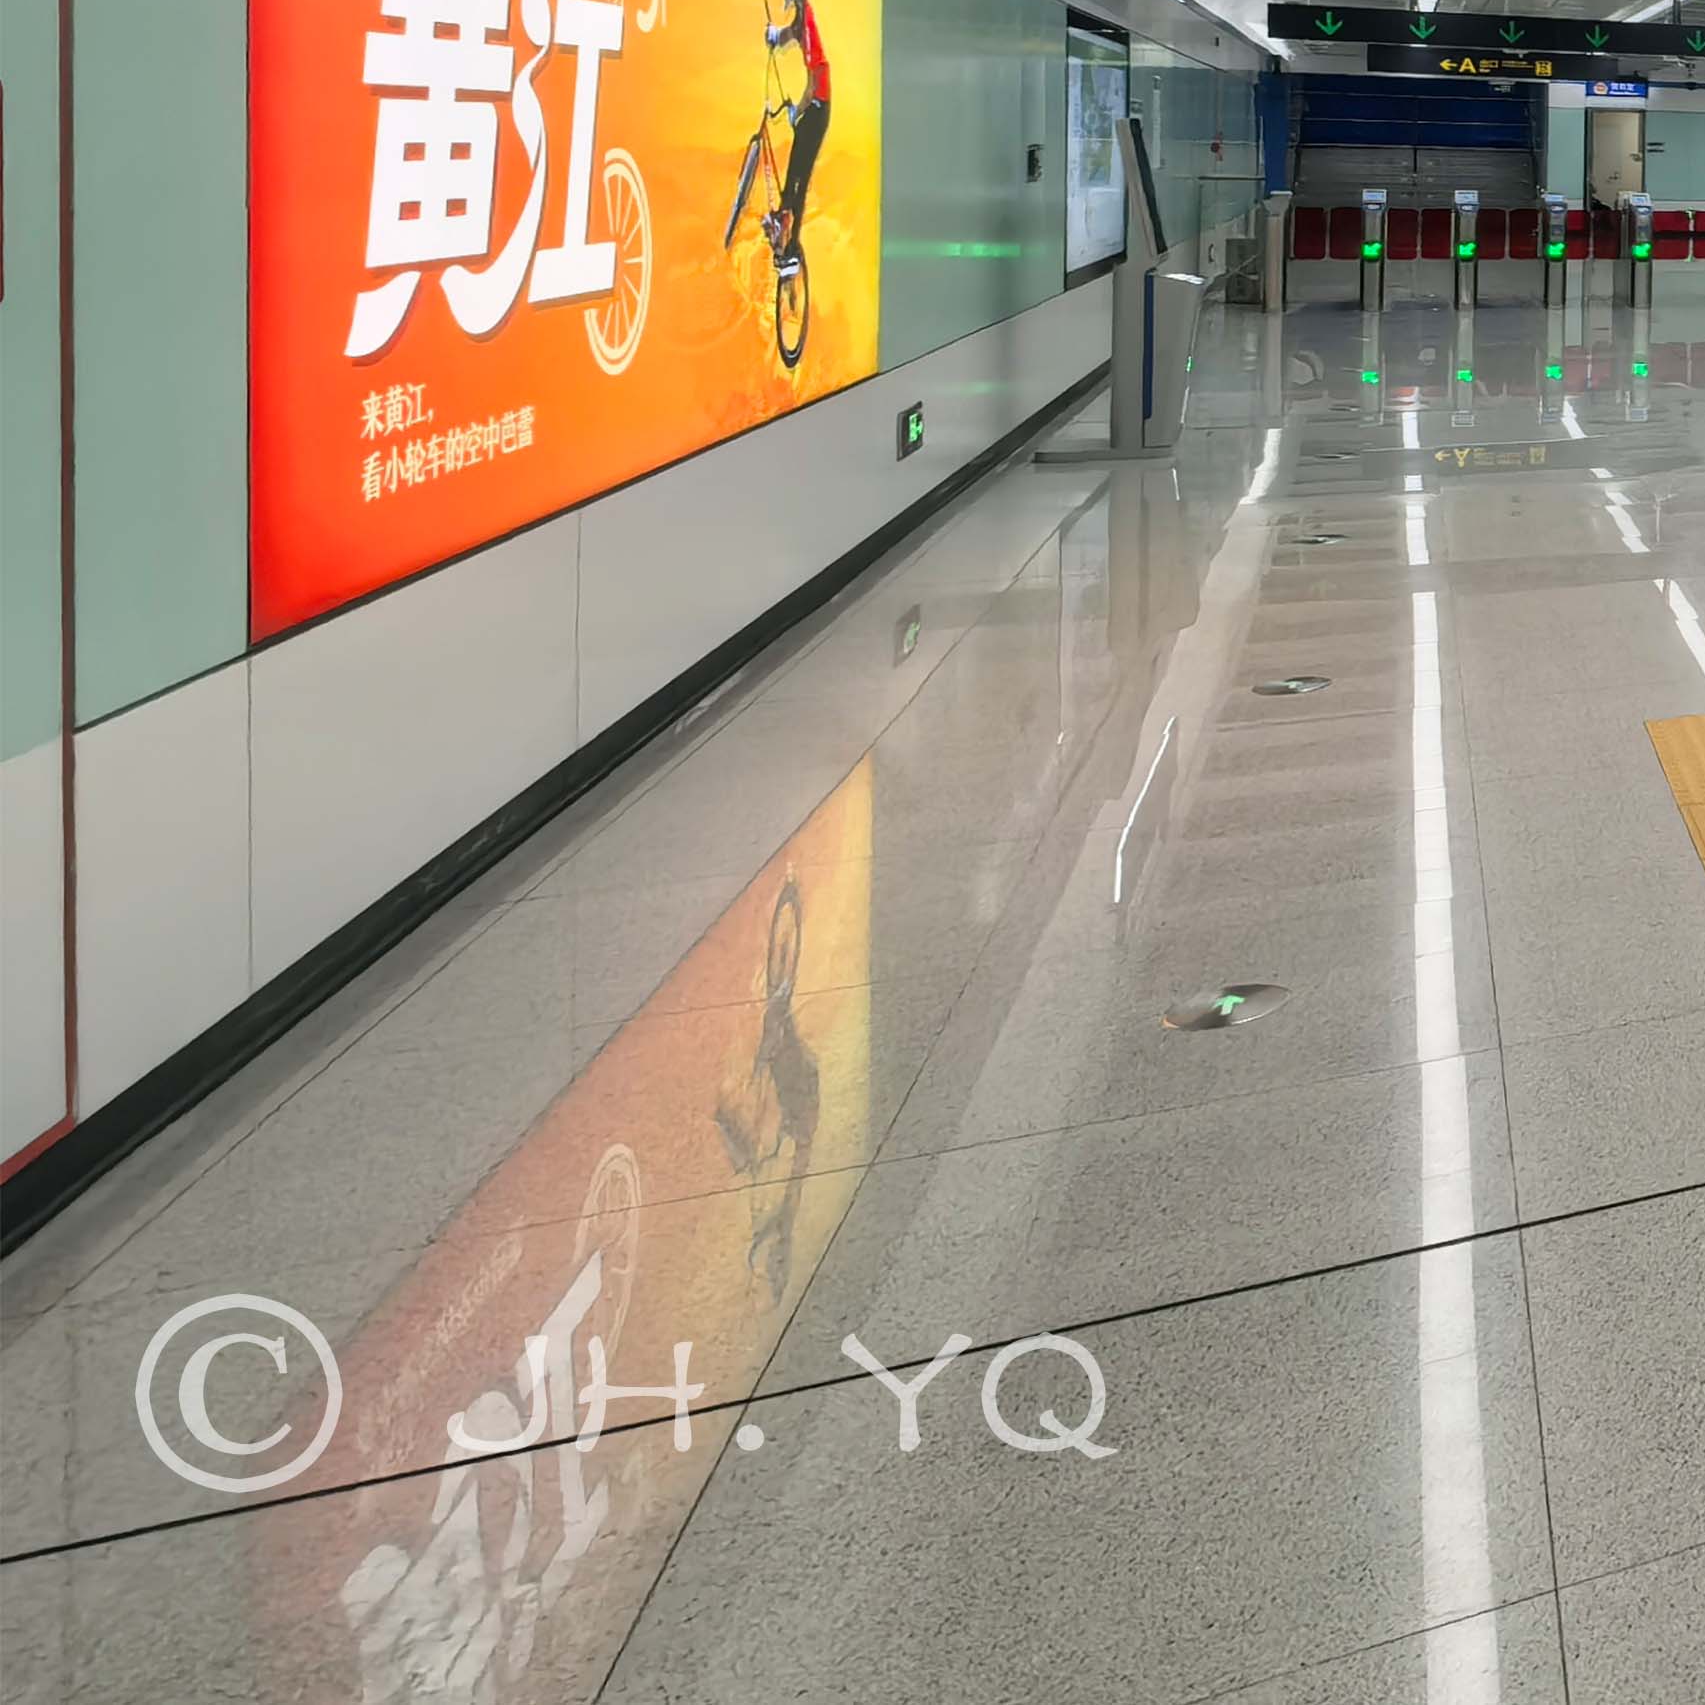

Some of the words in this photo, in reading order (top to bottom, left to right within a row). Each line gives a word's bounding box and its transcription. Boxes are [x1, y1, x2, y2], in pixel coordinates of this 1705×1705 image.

[1459, 57, 1476, 73] A
[361, 406, 535, 502] 看小轮车的空中芭蕾
